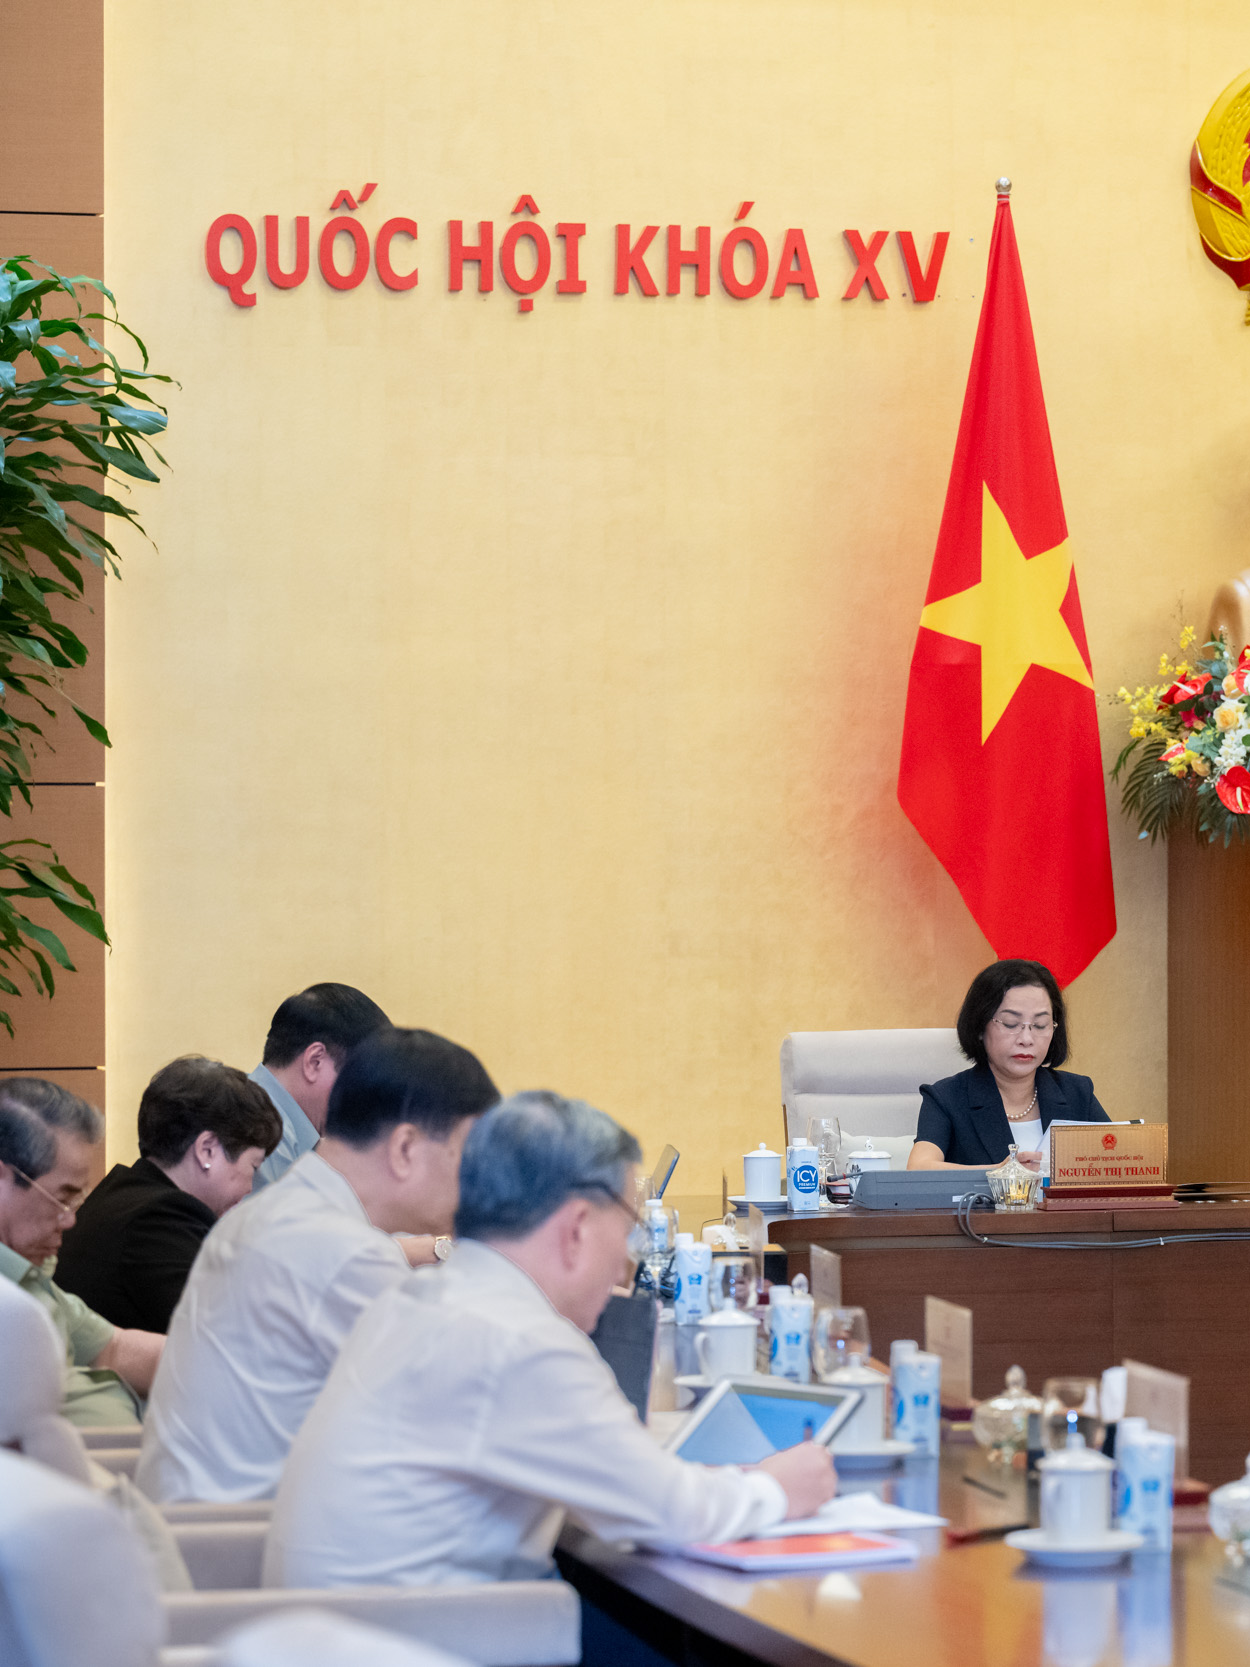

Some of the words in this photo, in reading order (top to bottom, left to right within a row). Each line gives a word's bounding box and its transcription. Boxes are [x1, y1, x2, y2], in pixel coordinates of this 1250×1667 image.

[204, 182, 419, 307] QUỐC
[447, 194, 587, 312] HỘI
[613, 201, 819, 300] KHÓA
[842, 228, 951, 303] XV
[797, 1170, 816, 1182] ICY
[1058, 1162, 1102, 1177] NGUYỄN
[1104, 1167, 1122, 1178] THỊ
[1124, 1166, 1160, 1176] THANH
